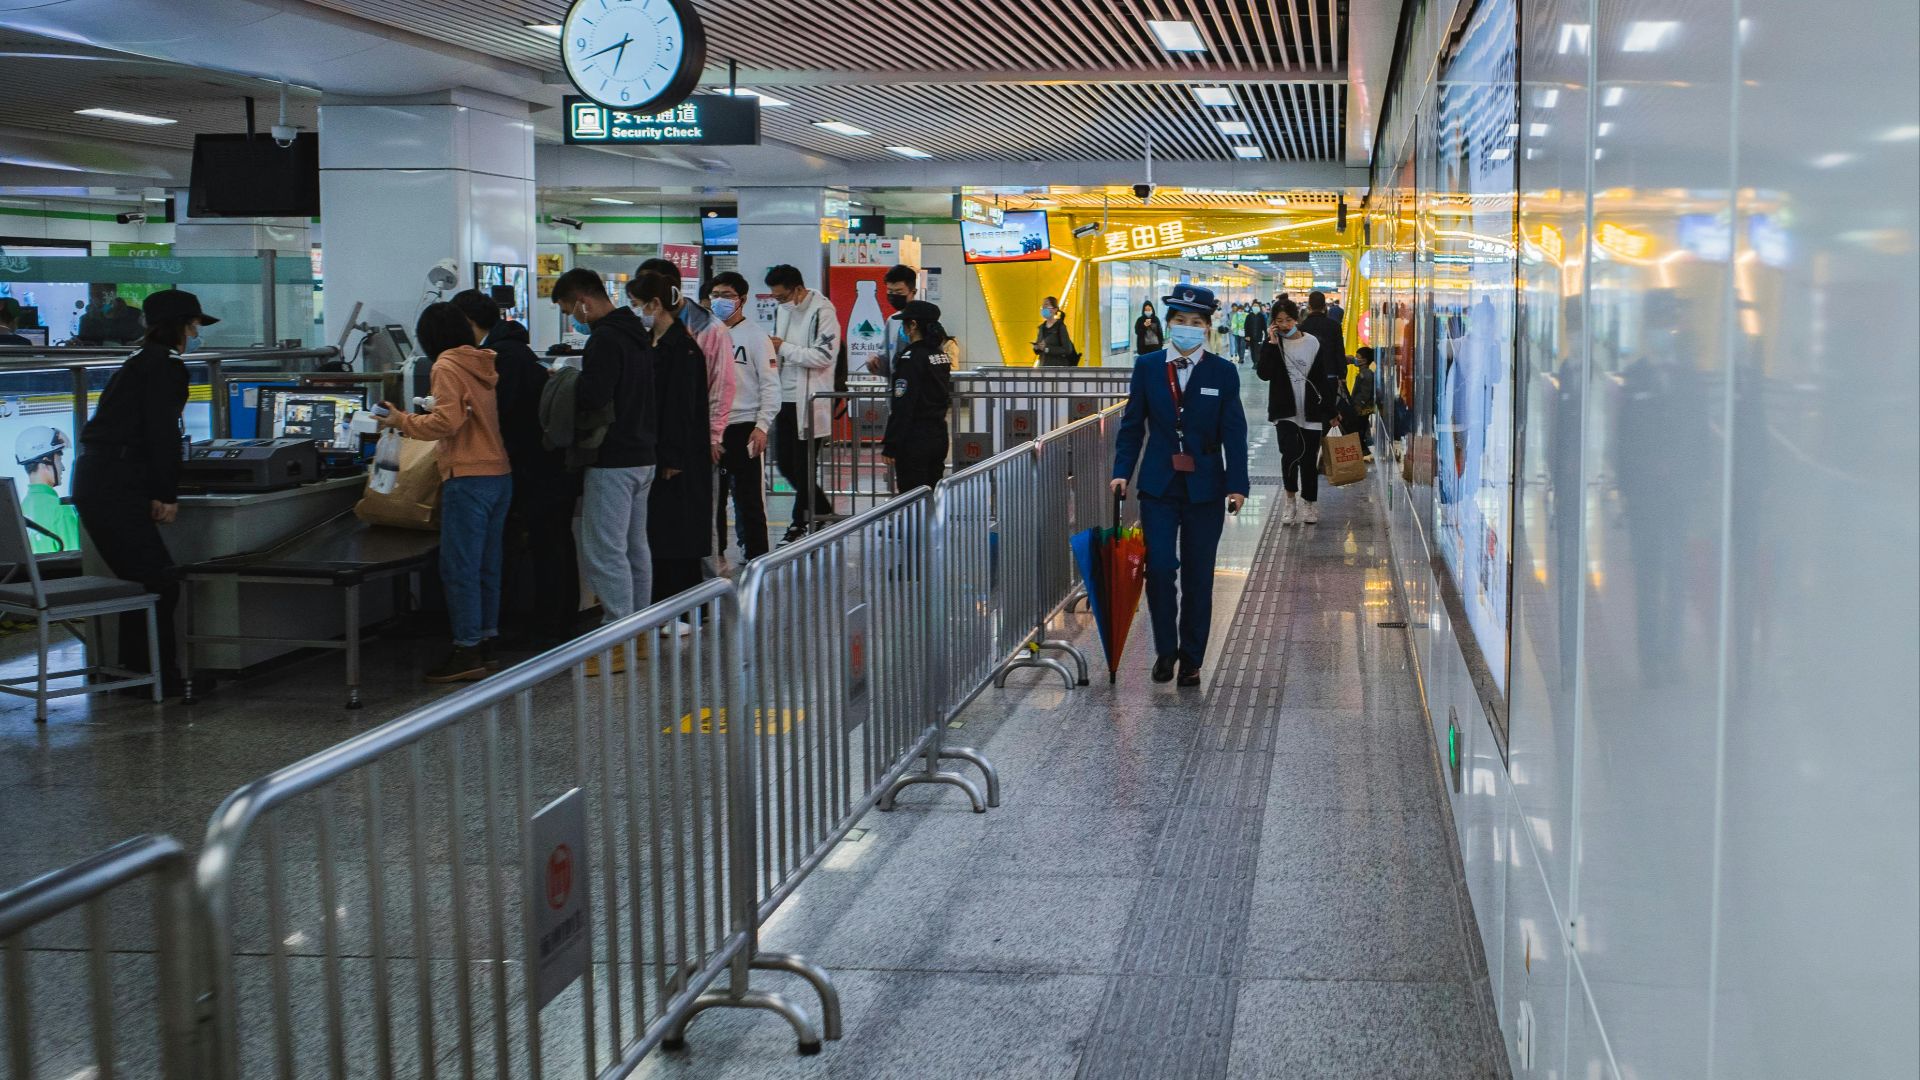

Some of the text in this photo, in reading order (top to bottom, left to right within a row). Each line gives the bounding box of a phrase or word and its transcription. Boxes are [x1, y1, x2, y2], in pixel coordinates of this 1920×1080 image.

[577, 38, 586, 52] 9
[665, 36, 674, 52] 3
[620, 86, 630, 101] 6
[611, 126, 702, 139] Security Check
[1104, 220, 1185, 254] 麦田里
[1181, 236, 1260, 258] 地铁商业街
